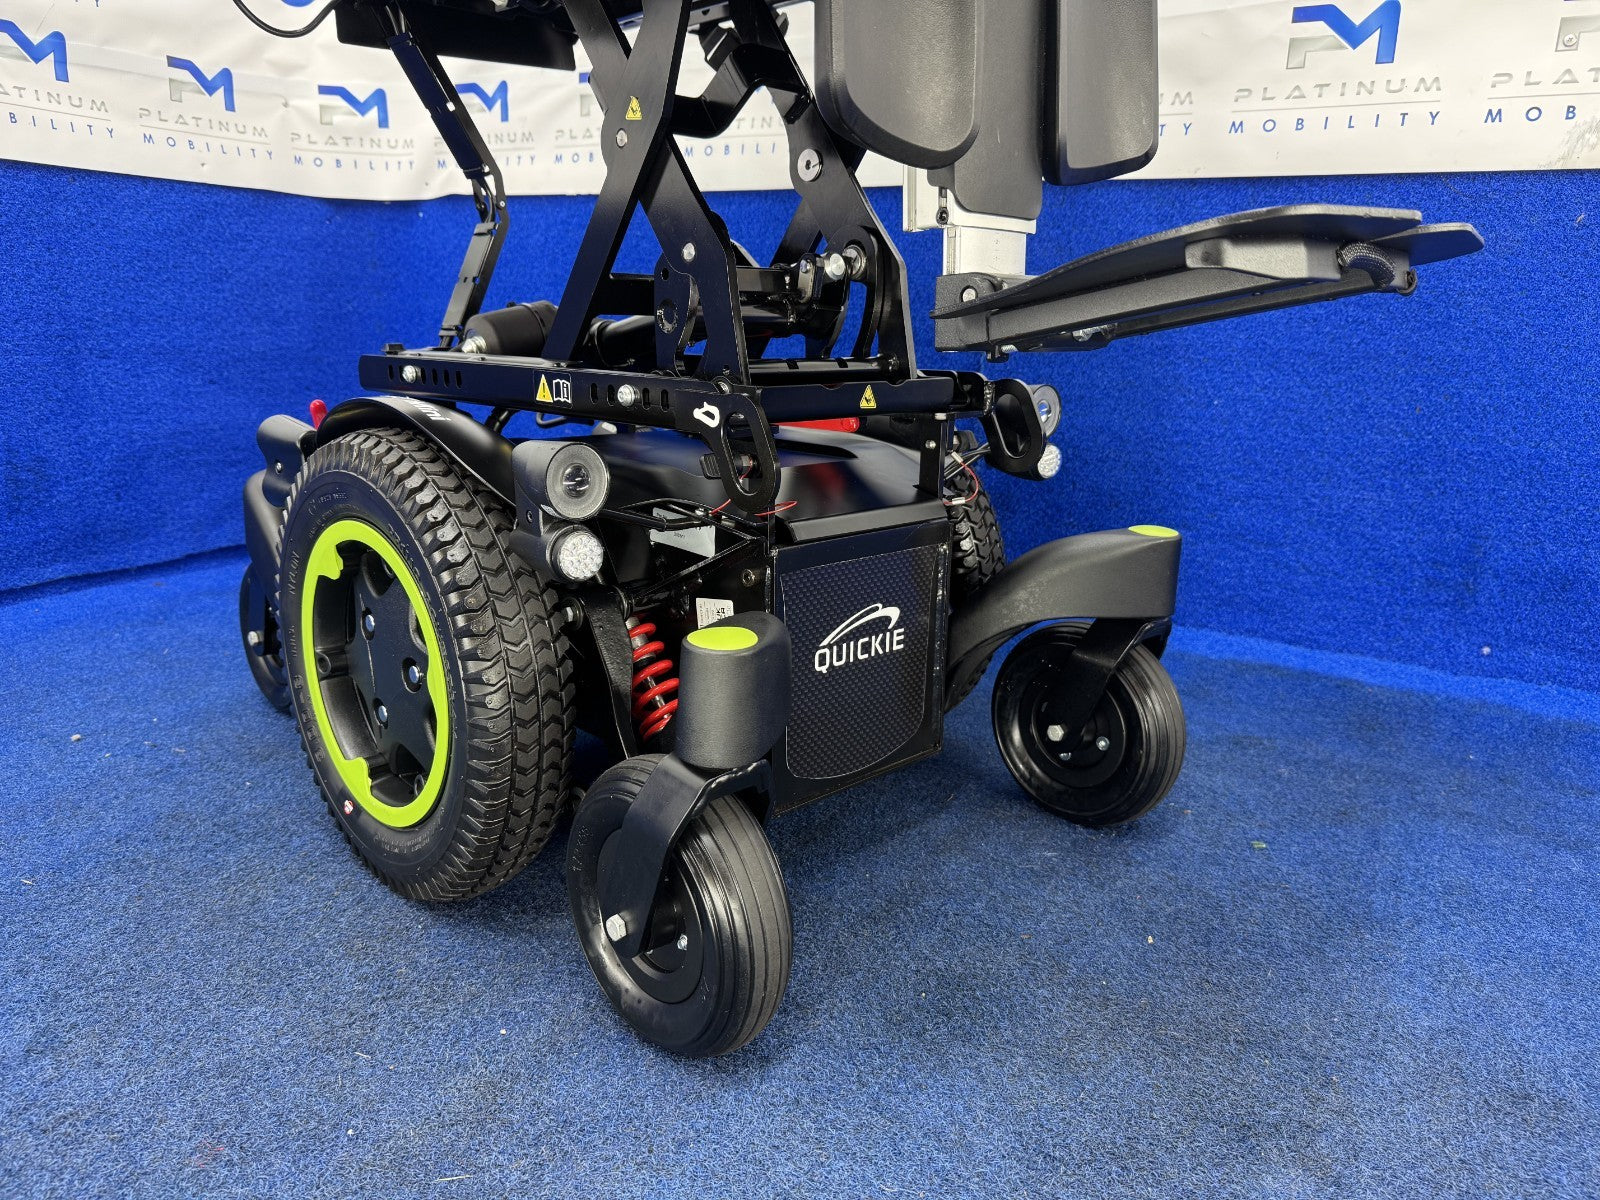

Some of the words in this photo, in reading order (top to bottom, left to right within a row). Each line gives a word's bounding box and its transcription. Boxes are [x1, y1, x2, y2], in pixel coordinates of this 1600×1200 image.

[1233, 76, 1443, 103] PLATINUM
[138, 107, 269, 139] PLATINUM
[1228, 111, 1441, 134] MOBILITY
[143, 132, 274, 161] MOBILITY
[290, 131, 415, 150] PLATINUM
[294, 154, 415, 172] MOBILITY
[814, 627, 905, 674] QUICKIE
